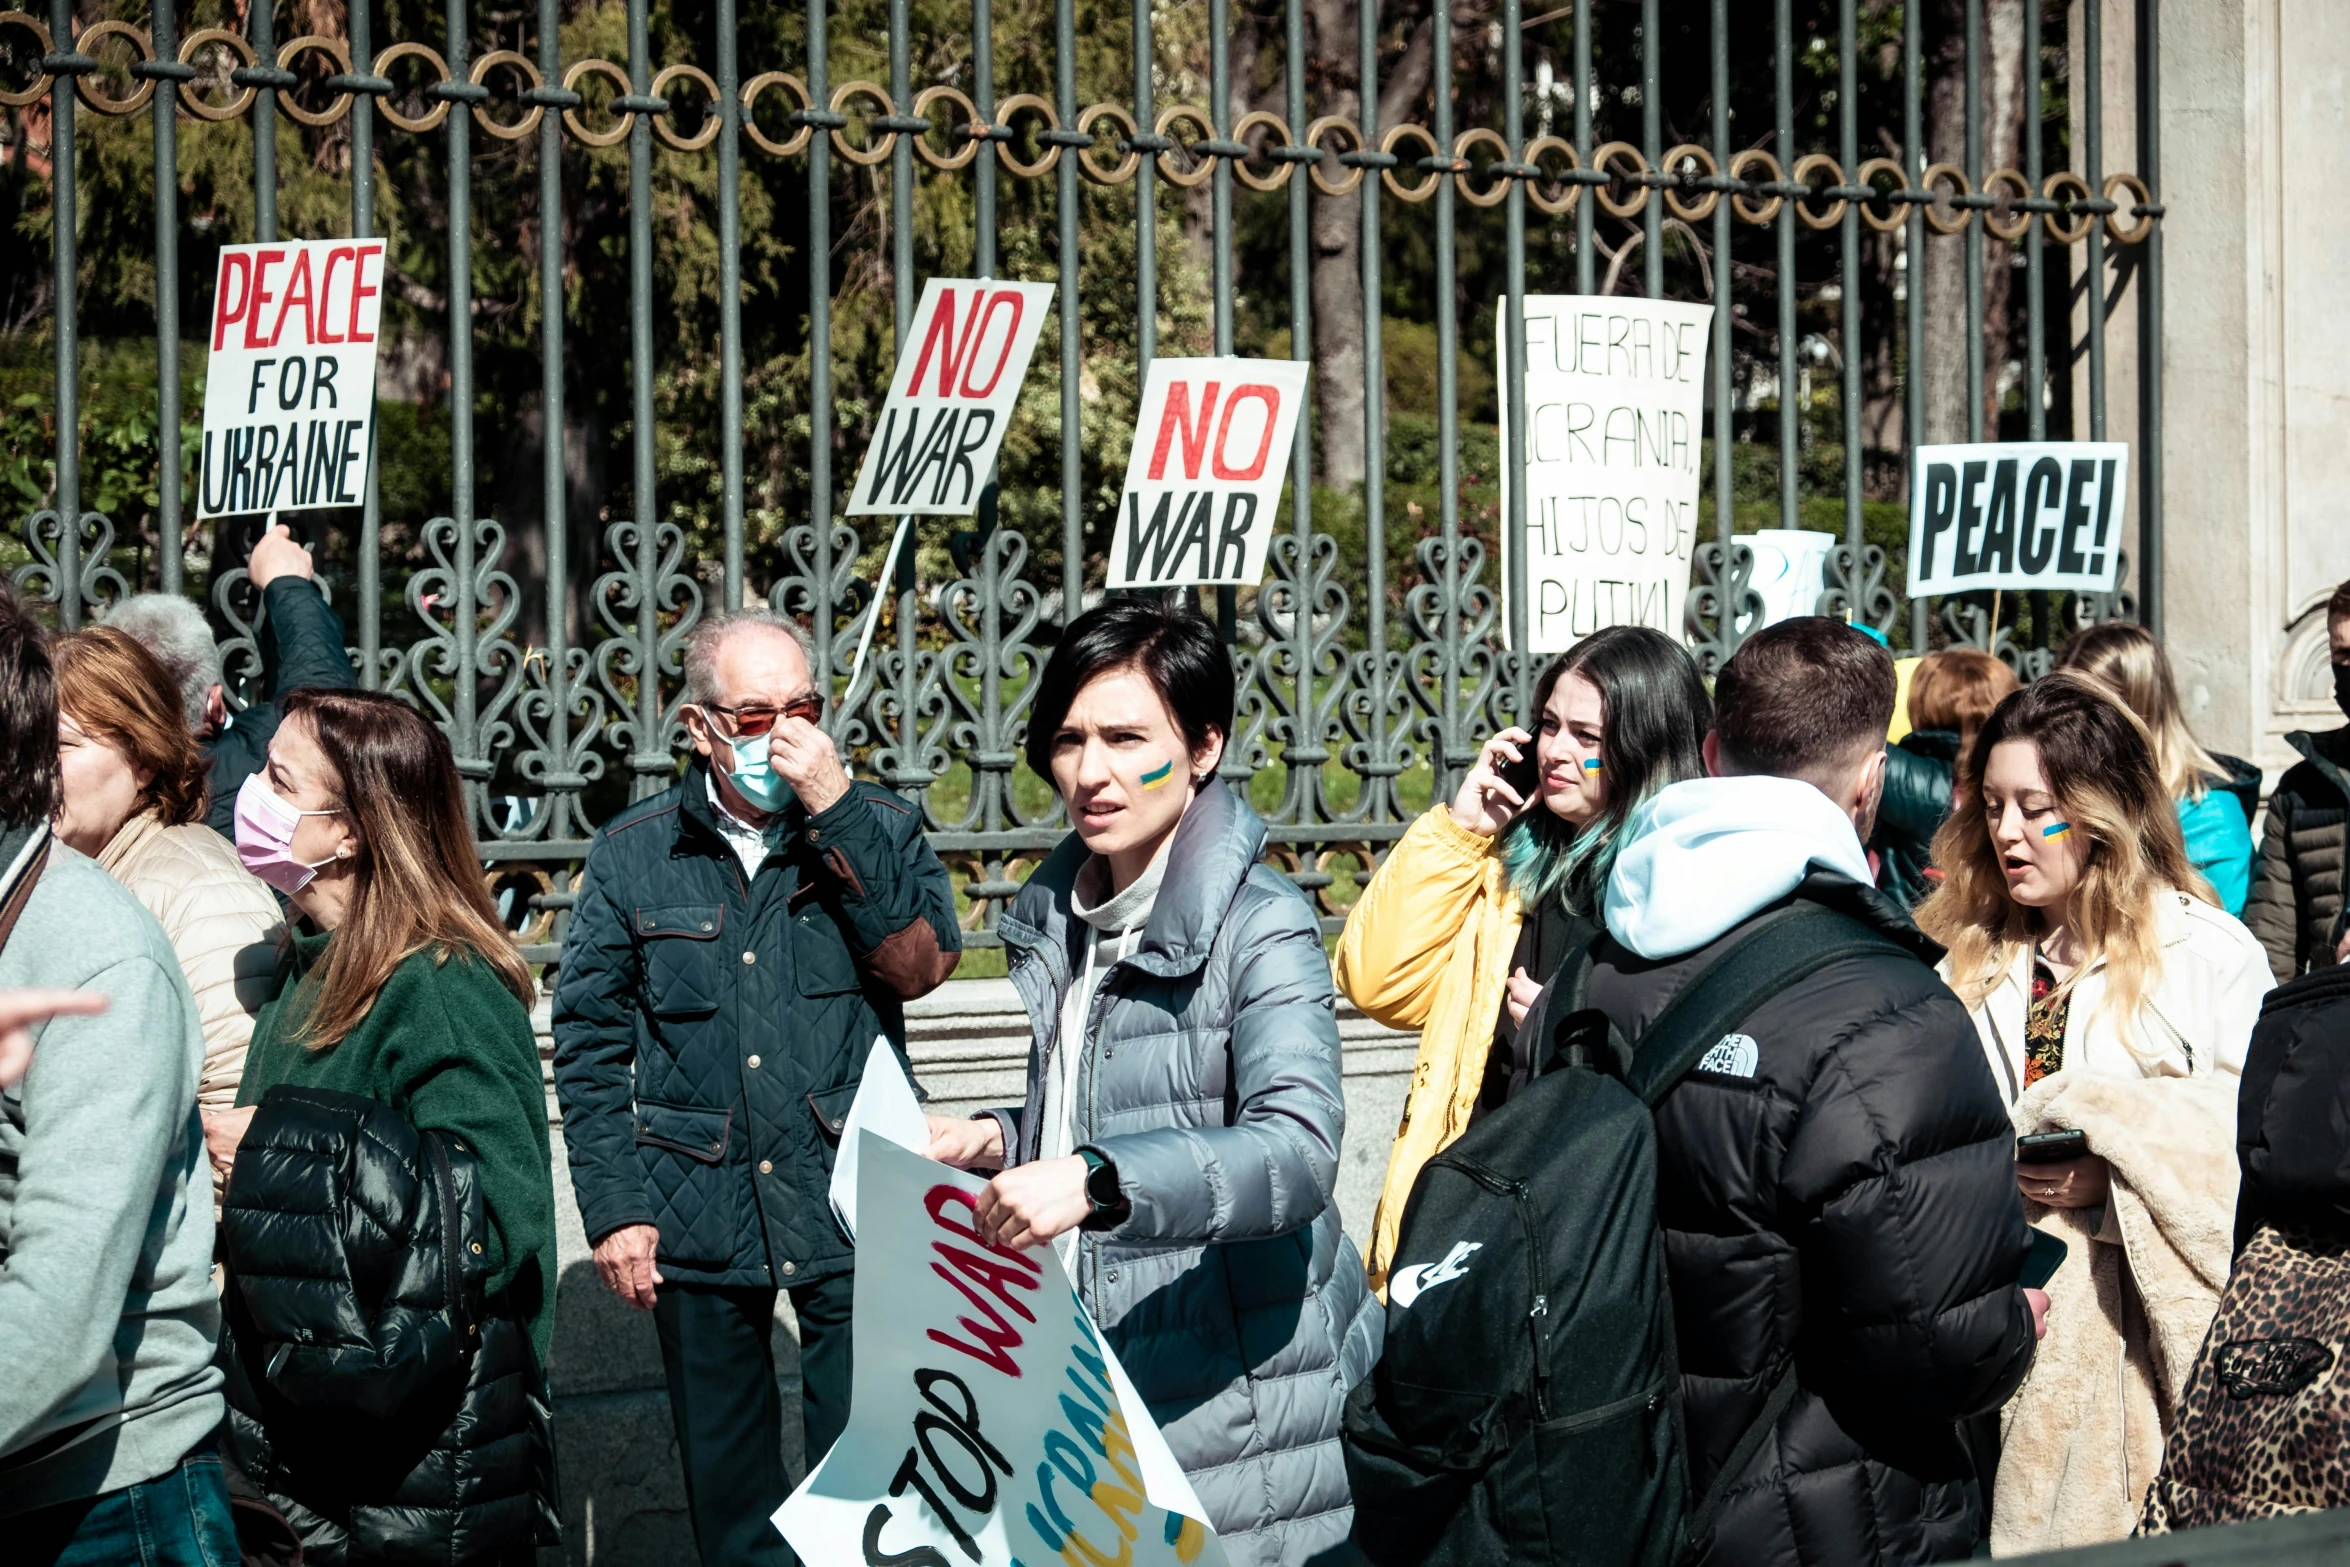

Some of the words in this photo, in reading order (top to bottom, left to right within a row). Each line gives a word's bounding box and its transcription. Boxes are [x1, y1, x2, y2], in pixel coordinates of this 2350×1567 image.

[213, 245, 382, 351] PEACE
[906, 287, 1024, 399] NO
[247, 355, 339, 414] FOR
[1524, 313, 1653, 378] FUERA
[1663, 320, 1696, 383] DE
[203, 419, 363, 514] UKRAINE
[867, 406, 996, 506] WAR
[1147, 380, 1280, 481] NO
[1125, 490, 1258, 582] WAR
[1664, 498, 1690, 561] DE
[1919, 456, 2117, 581] PEACE!
[1698, 1054, 1733, 1075] FACE
